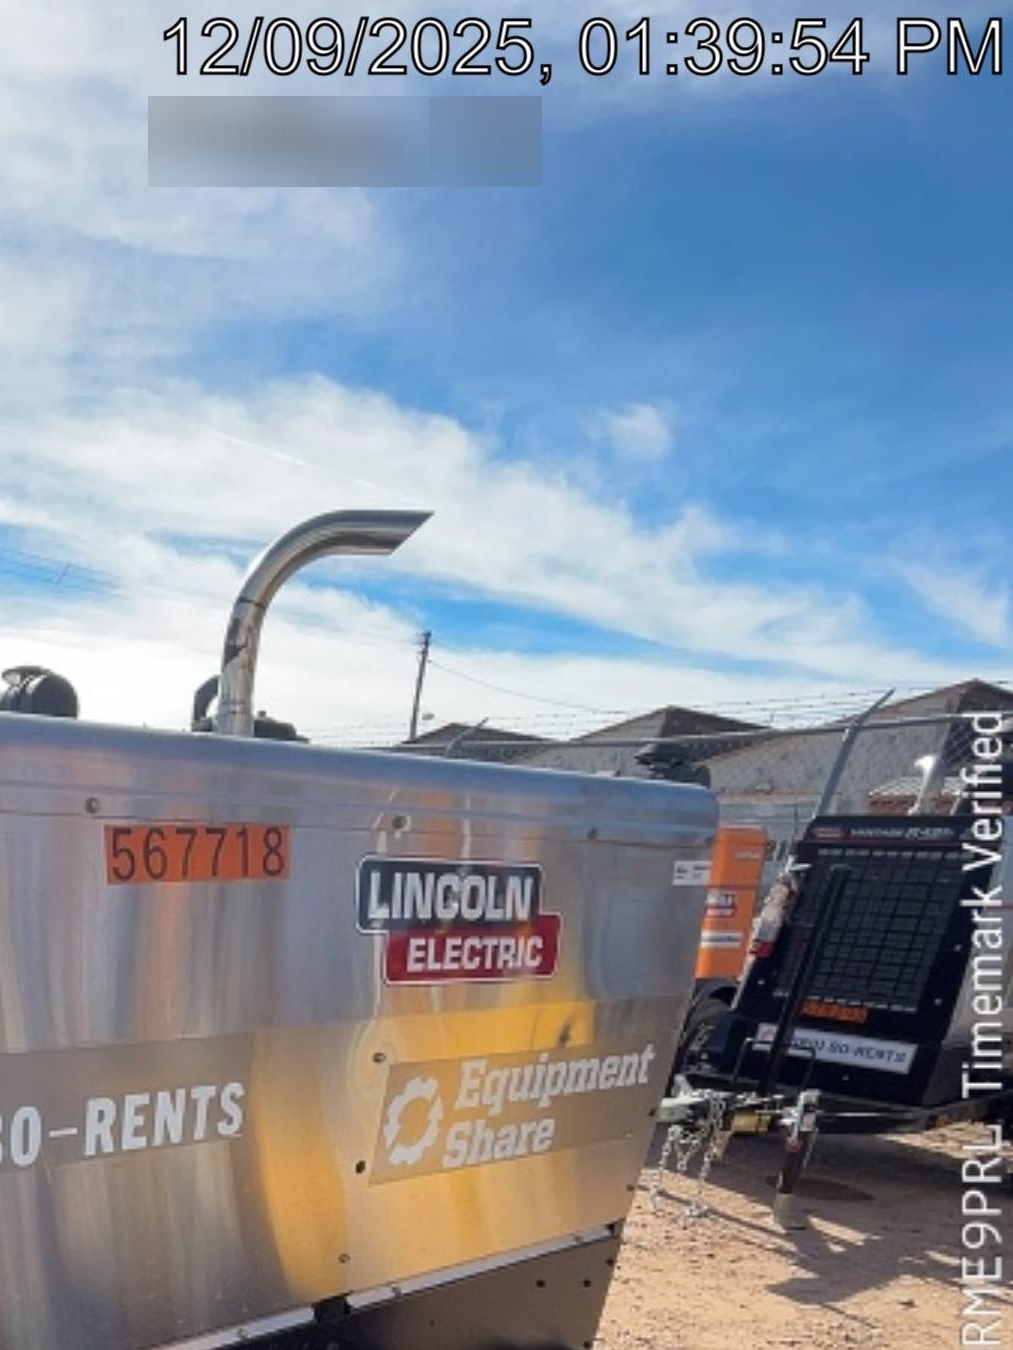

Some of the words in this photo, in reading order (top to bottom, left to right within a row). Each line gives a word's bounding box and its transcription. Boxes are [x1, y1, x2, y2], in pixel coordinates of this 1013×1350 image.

[110, 825, 286, 881] 567718
[366, 869, 534, 921] LINCOLN
[405, 935, 544, 974] ELECTRIC
[453, 1043, 657, 1114] Equipment
[441, 1116, 555, 1167] Share
